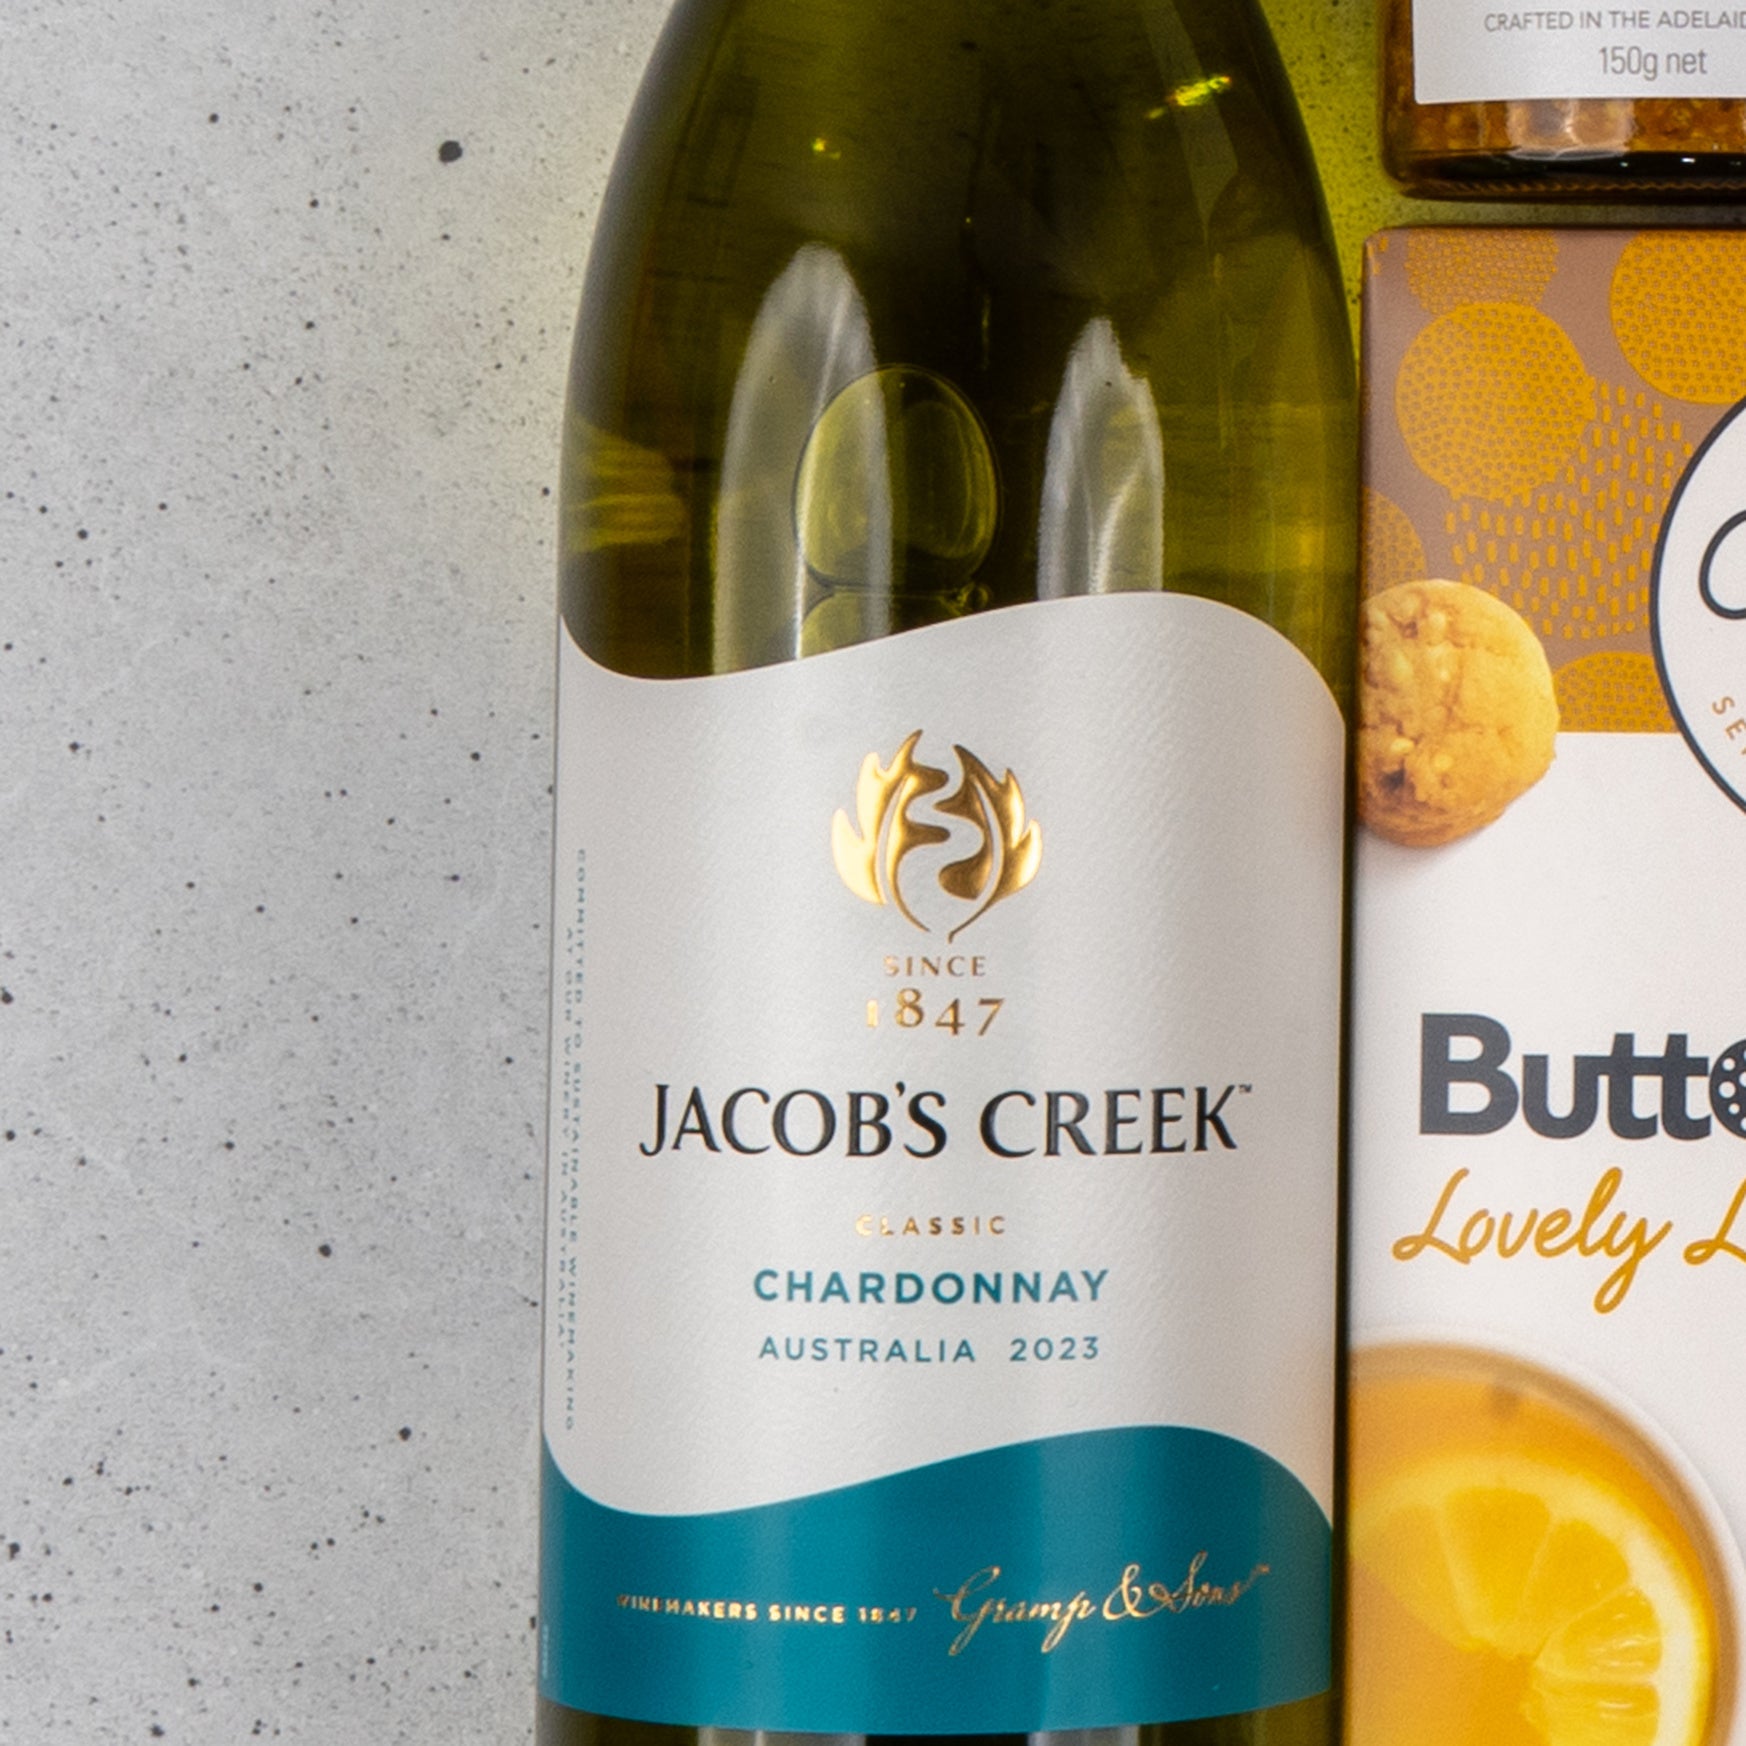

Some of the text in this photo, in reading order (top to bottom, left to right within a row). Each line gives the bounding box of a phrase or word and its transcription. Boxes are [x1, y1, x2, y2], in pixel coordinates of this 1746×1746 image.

[1483, 11, 1574, 32] CRAFTED
[1580, 11, 1602, 30] IN
[1610, 10, 1650, 30] THE
[1599, 46, 1708, 81] 150g net
[565, 928, 573, 955] AT
[883, 955, 987, 977] SINCE
[563, 971, 573, 1021] OUR
[866, 987, 1005, 1036] 1847
[639, 1081, 948, 1158] JACOB'S
[565, 848, 586, 1431] COMMITTED TO SUSTAINABLE WINEMAKING
[560, 1152, 569, 1176] IN
[855, 1214, 1006, 1237] CLASSIC
[1392, 1166, 1673, 1314] Lovely
[754, 1269, 1109, 1304] CHARDONNAY
[758, 1336, 1100, 1363] AUSTRALIA 2023
[616, 1594, 917, 1624] WINEMAKERS SINCE 1847
[933, 1566, 1096, 1656] Gramp
[1102, 1563, 1153, 1620] &
